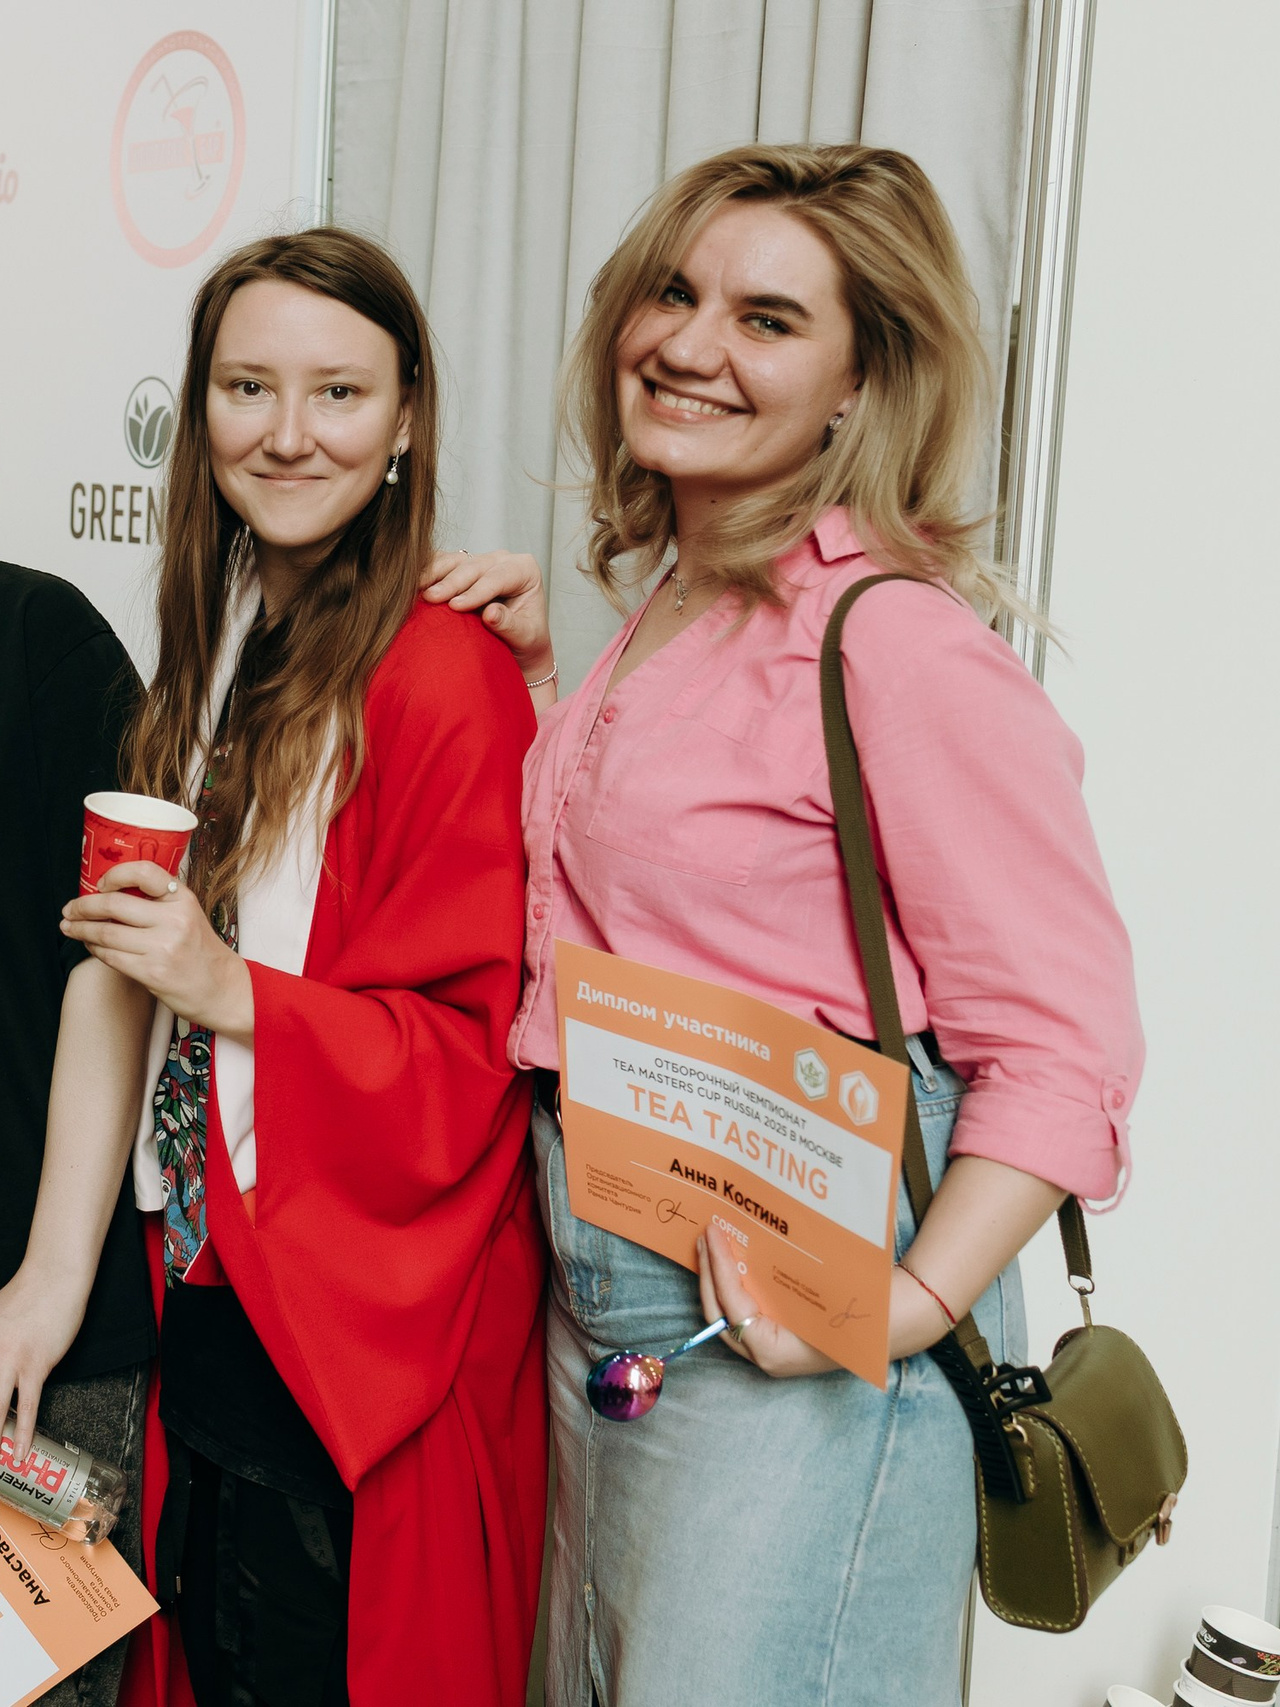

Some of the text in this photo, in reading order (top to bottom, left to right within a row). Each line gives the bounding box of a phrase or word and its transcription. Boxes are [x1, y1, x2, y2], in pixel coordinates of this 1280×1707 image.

[576, 981, 769, 1062] Диплом участника
[612, 1058, 635, 1074] TEA
[638, 1066, 693, 1093] MASTERS
[697, 1086, 721, 1101] CUP
[724, 1096, 760, 1121] RUSSIA
[764, 1115, 786, 1136] 2025
[799, 1135, 842, 1168] МОСКВЕ
[654, 1057, 806, 1129] ОТБОРОЧНЫЙ ЧЕМПИОНАТ
[626, 1083, 828, 1200] TEA TASTING
[669, 1158, 788, 1235] Анна Костина
[712, 1213, 747, 1248] COFFEE
[40, 1449, 70, 1468] ACTIVATED
[67, 1481, 81, 1504] STILL
[59, 1555, 107, 1616] Организационного
[66, 1576, 100, 1622] Председатель
[89, 1581, 113, 1611] комитета
[103, 1586, 120, 1607] Рамаз
